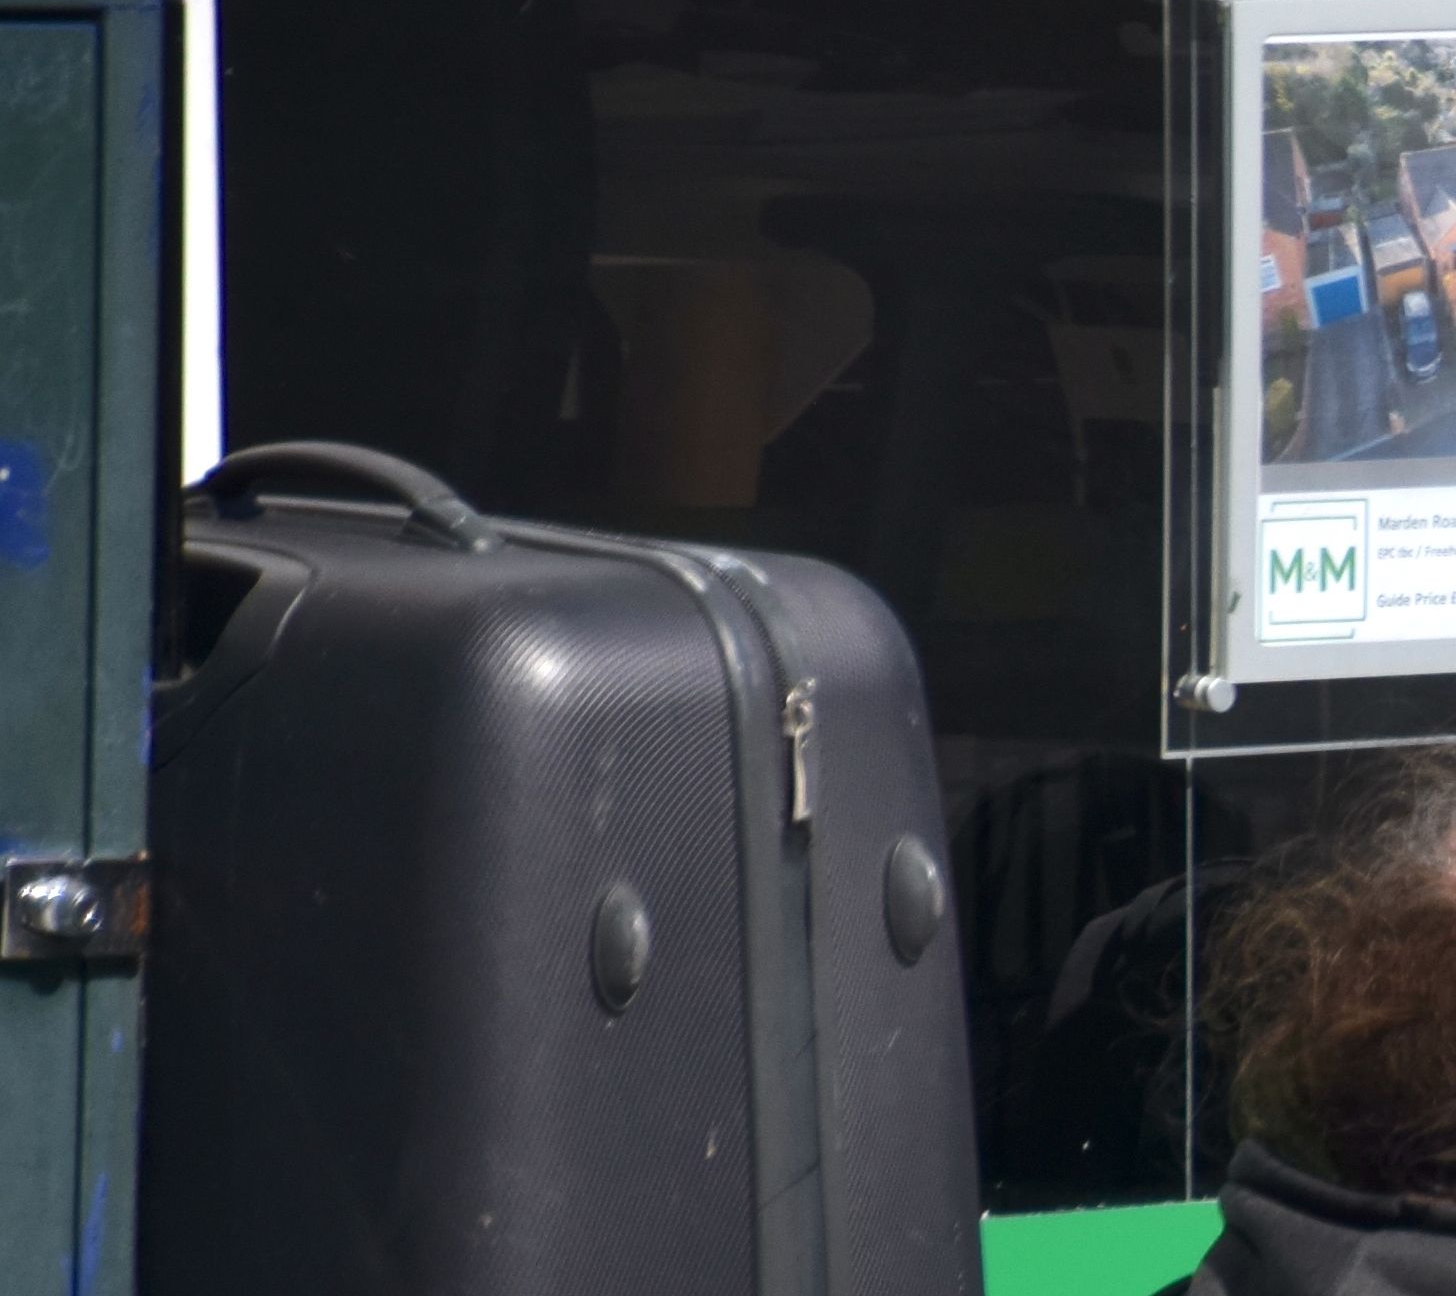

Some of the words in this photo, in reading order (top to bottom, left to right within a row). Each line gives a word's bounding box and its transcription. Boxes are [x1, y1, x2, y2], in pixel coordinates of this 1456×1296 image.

[1378, 516, 1427, 531] Marden
[1270, 546, 1356, 594] M&M
[1377, 594, 1411, 606] Guide
[1415, 593, 1447, 605] Price
